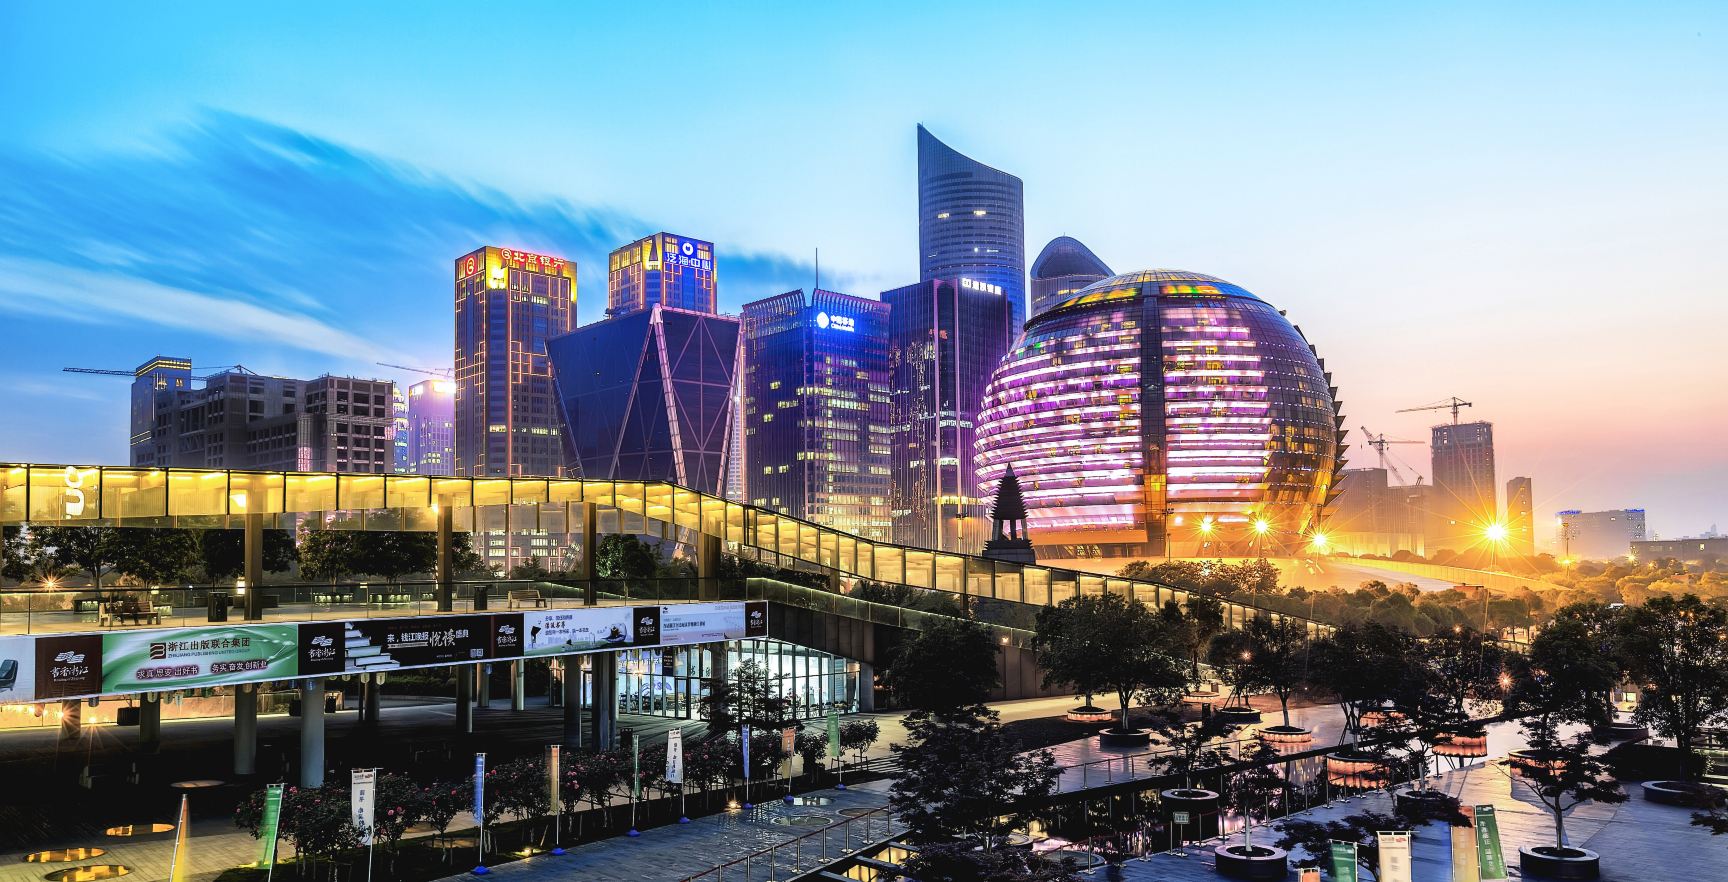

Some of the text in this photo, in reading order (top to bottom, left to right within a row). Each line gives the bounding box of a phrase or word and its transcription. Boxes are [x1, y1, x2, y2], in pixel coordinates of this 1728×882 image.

[513, 251, 565, 267] 北京银行
[167, 637, 250, 651] 浙江出版联合集团
